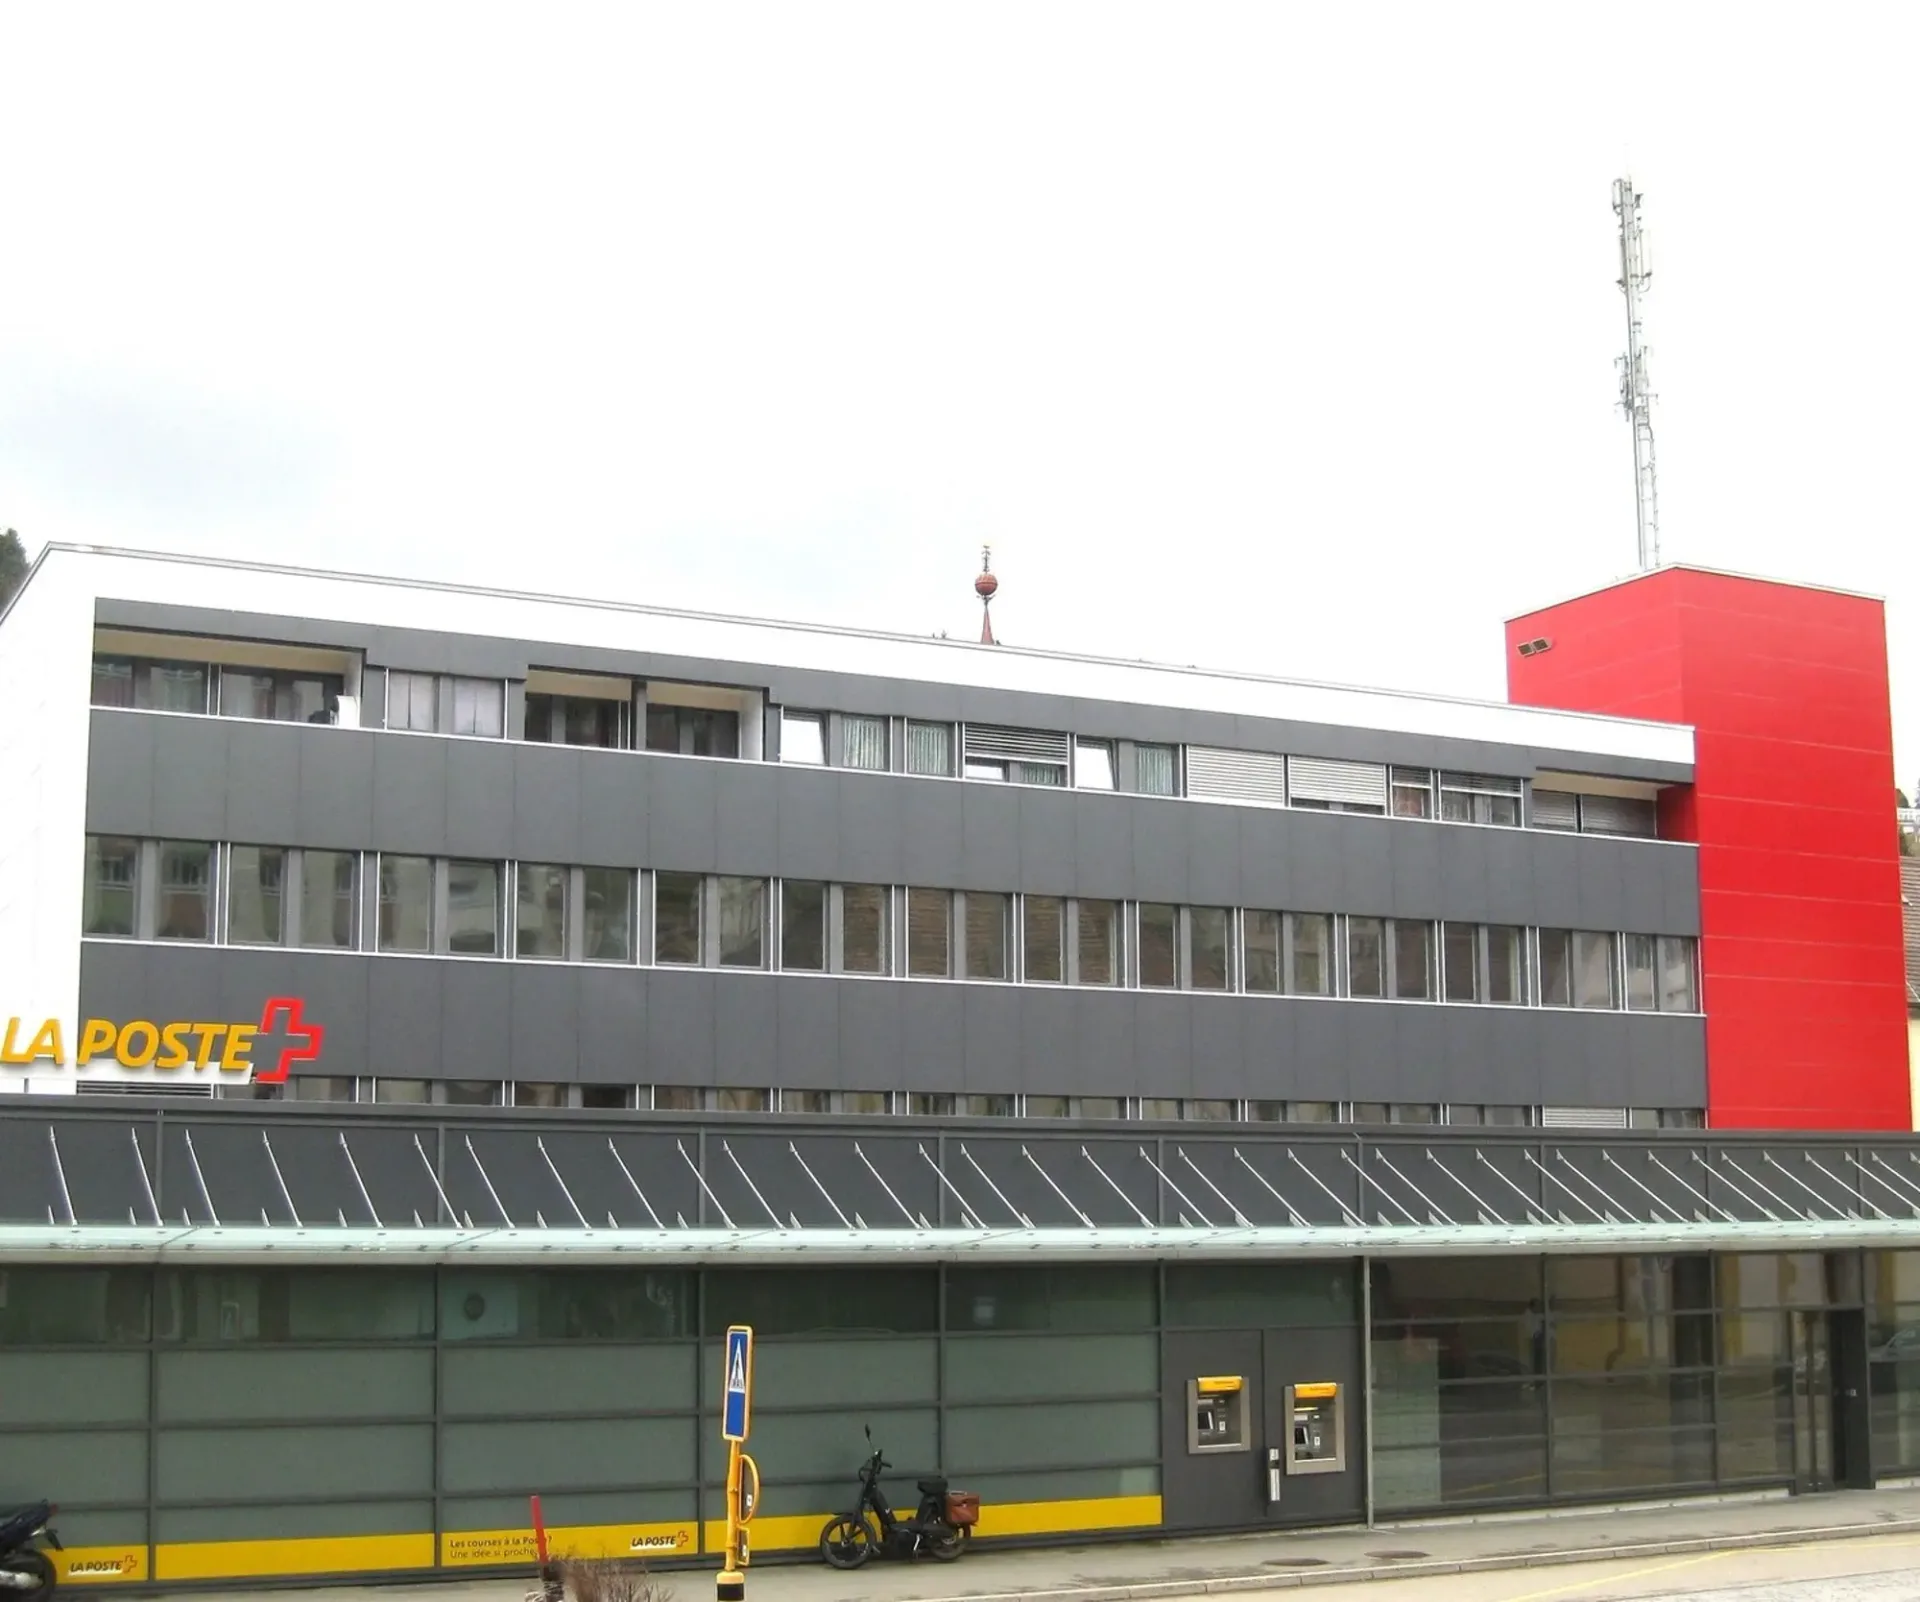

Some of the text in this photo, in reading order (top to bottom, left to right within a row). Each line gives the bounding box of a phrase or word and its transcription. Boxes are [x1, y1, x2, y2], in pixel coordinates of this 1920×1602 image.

[0, 1016, 258, 1071] LA POSTE
[450, 1539, 465, 1548] Les
[467, 1538, 501, 1547] courses
[631, 1535, 676, 1547] LA POSTE
[450, 1550, 468, 1558] Une
[70, 1560, 123, 1572] LA POSTE
